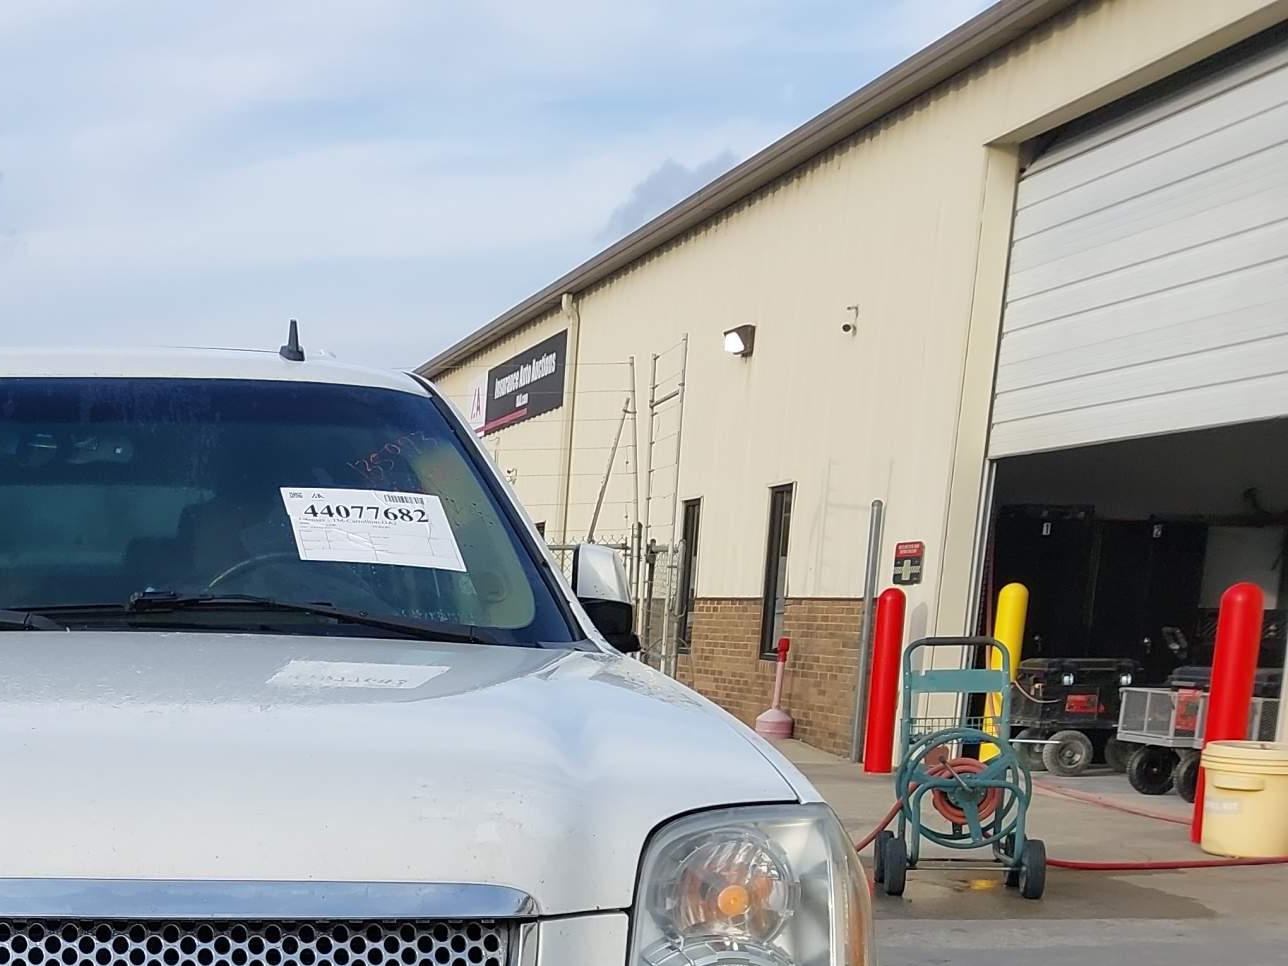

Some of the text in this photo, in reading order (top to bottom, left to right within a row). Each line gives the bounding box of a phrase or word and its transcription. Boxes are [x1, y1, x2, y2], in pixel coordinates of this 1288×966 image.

[494, 352, 556, 399] Insurance Auto Auctions
[304, 504, 429, 523] 44077682
